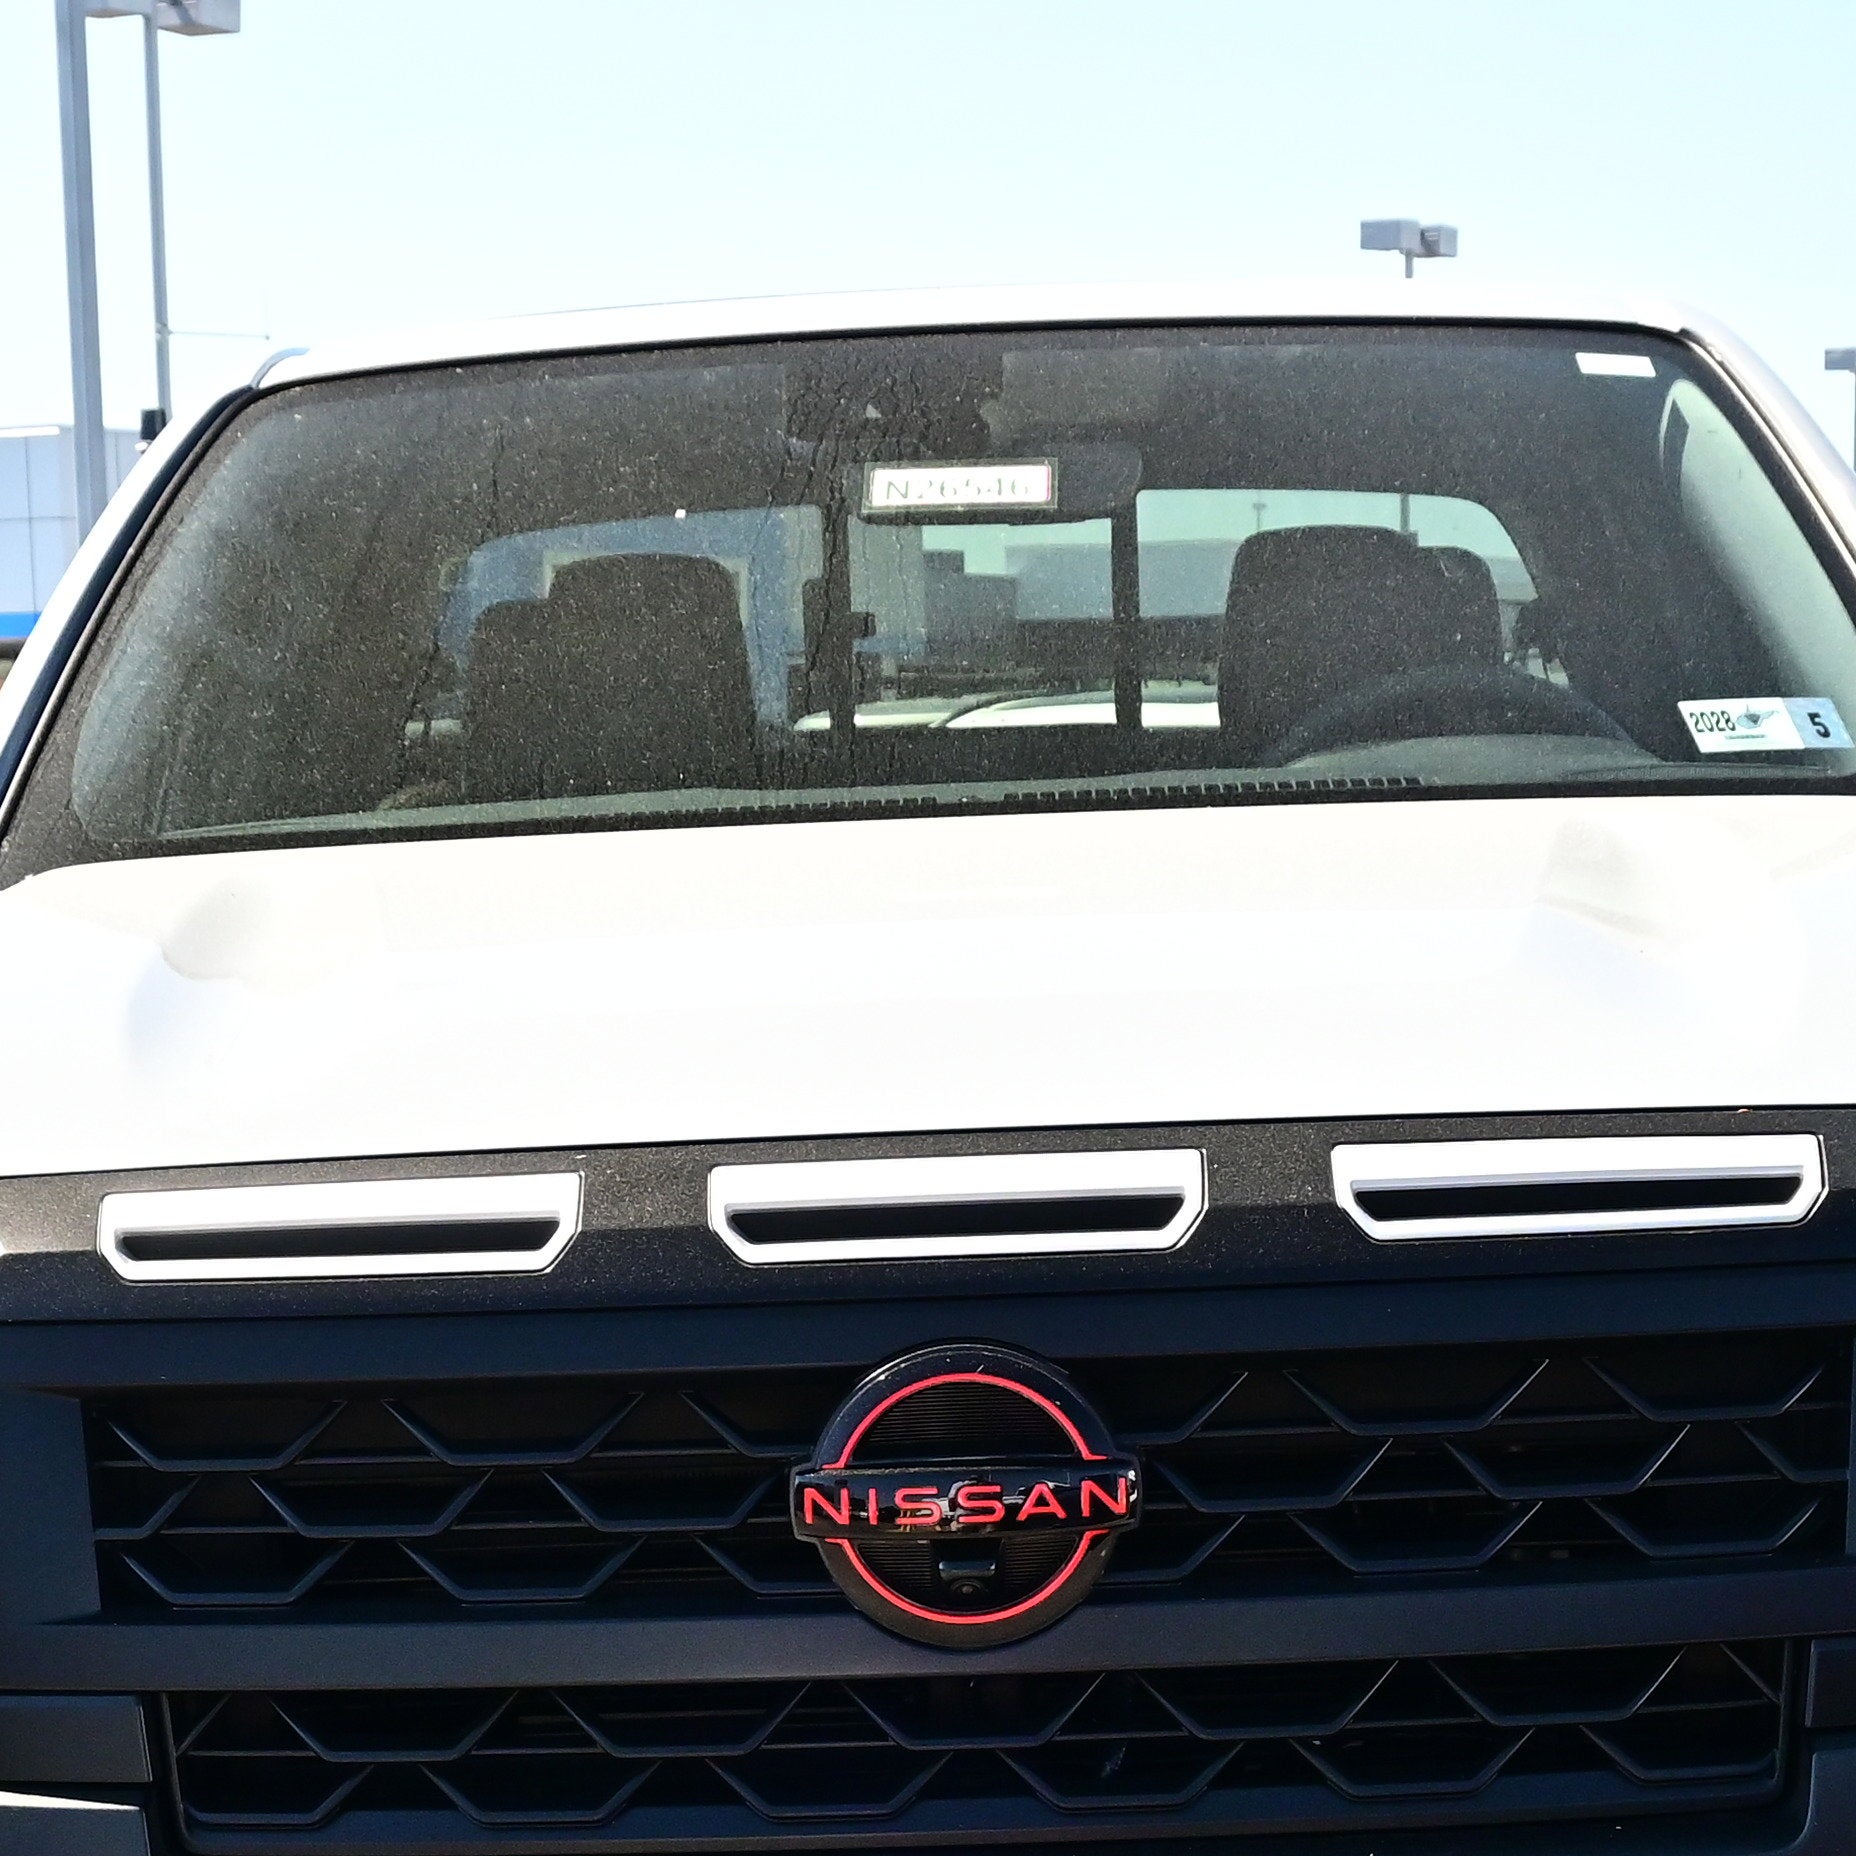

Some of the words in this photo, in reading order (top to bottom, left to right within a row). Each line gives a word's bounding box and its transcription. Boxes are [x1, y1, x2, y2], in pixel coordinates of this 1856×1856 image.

[1689, 710, 1737, 733] 2028
[1806, 712, 1831, 739] 5
[803, 1476, 1128, 1526] NISSAN
